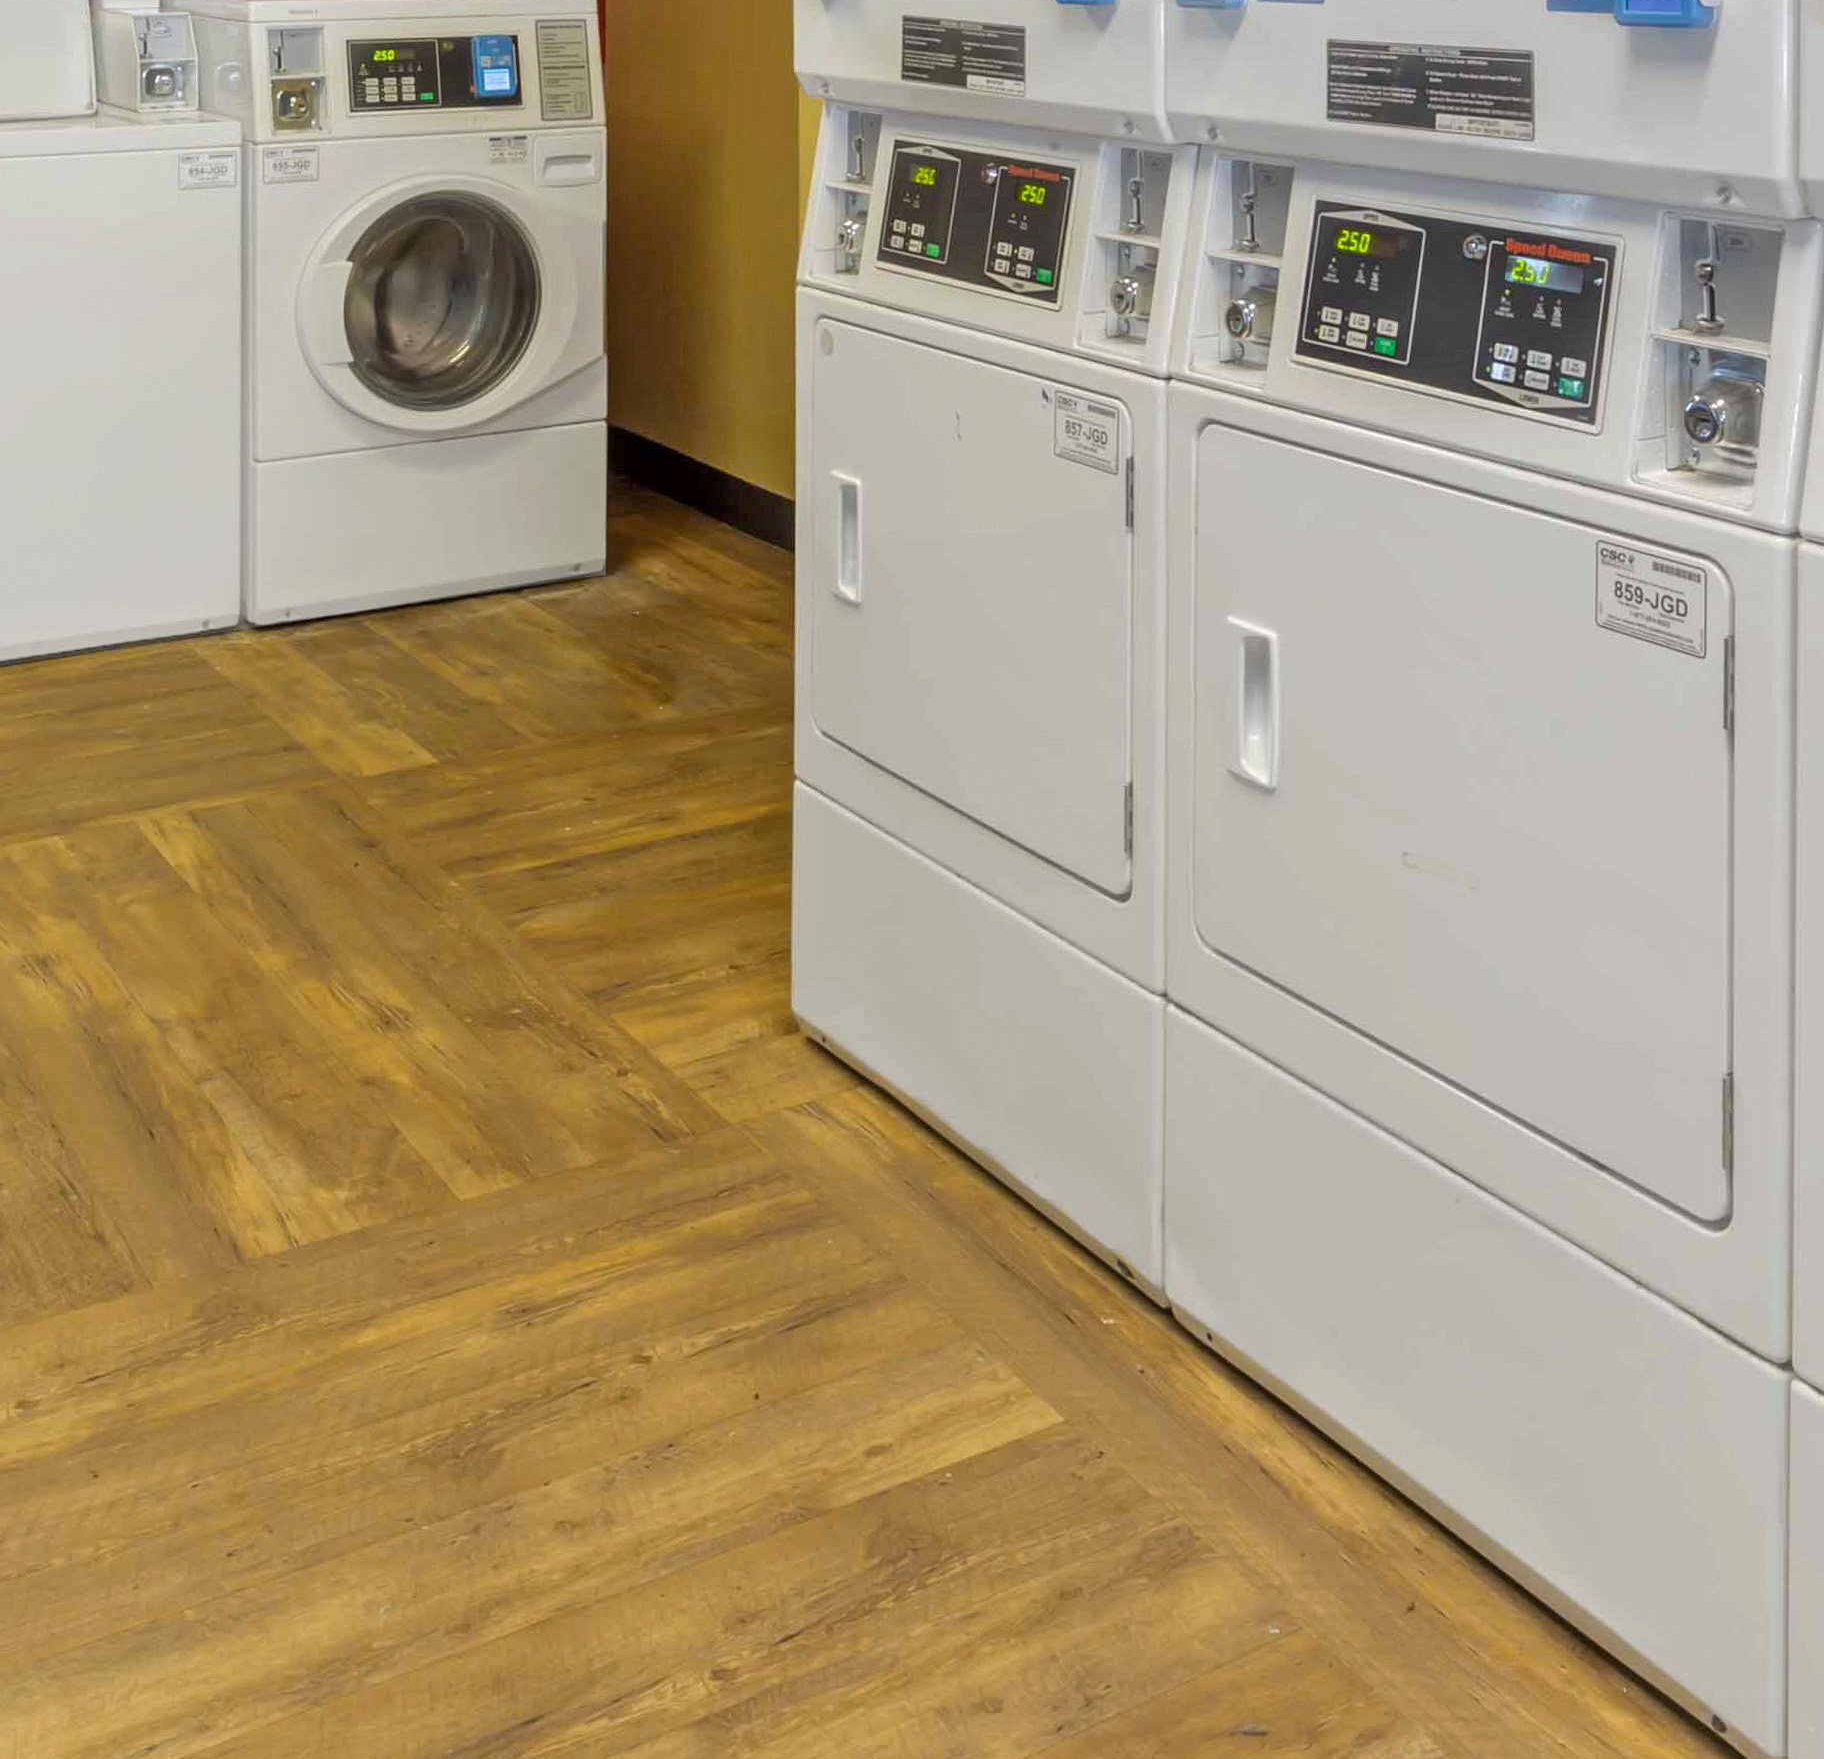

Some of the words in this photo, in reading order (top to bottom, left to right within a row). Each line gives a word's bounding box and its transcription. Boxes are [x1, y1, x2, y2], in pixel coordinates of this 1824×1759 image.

[1505, 238, 1547, 256] Speed
[1548, 244, 1592, 264] Queen
[1064, 419, 1108, 445] 857-JGD
[1600, 547, 1627, 563] CSC
[1614, 580, 1688, 617] 859-JGD
